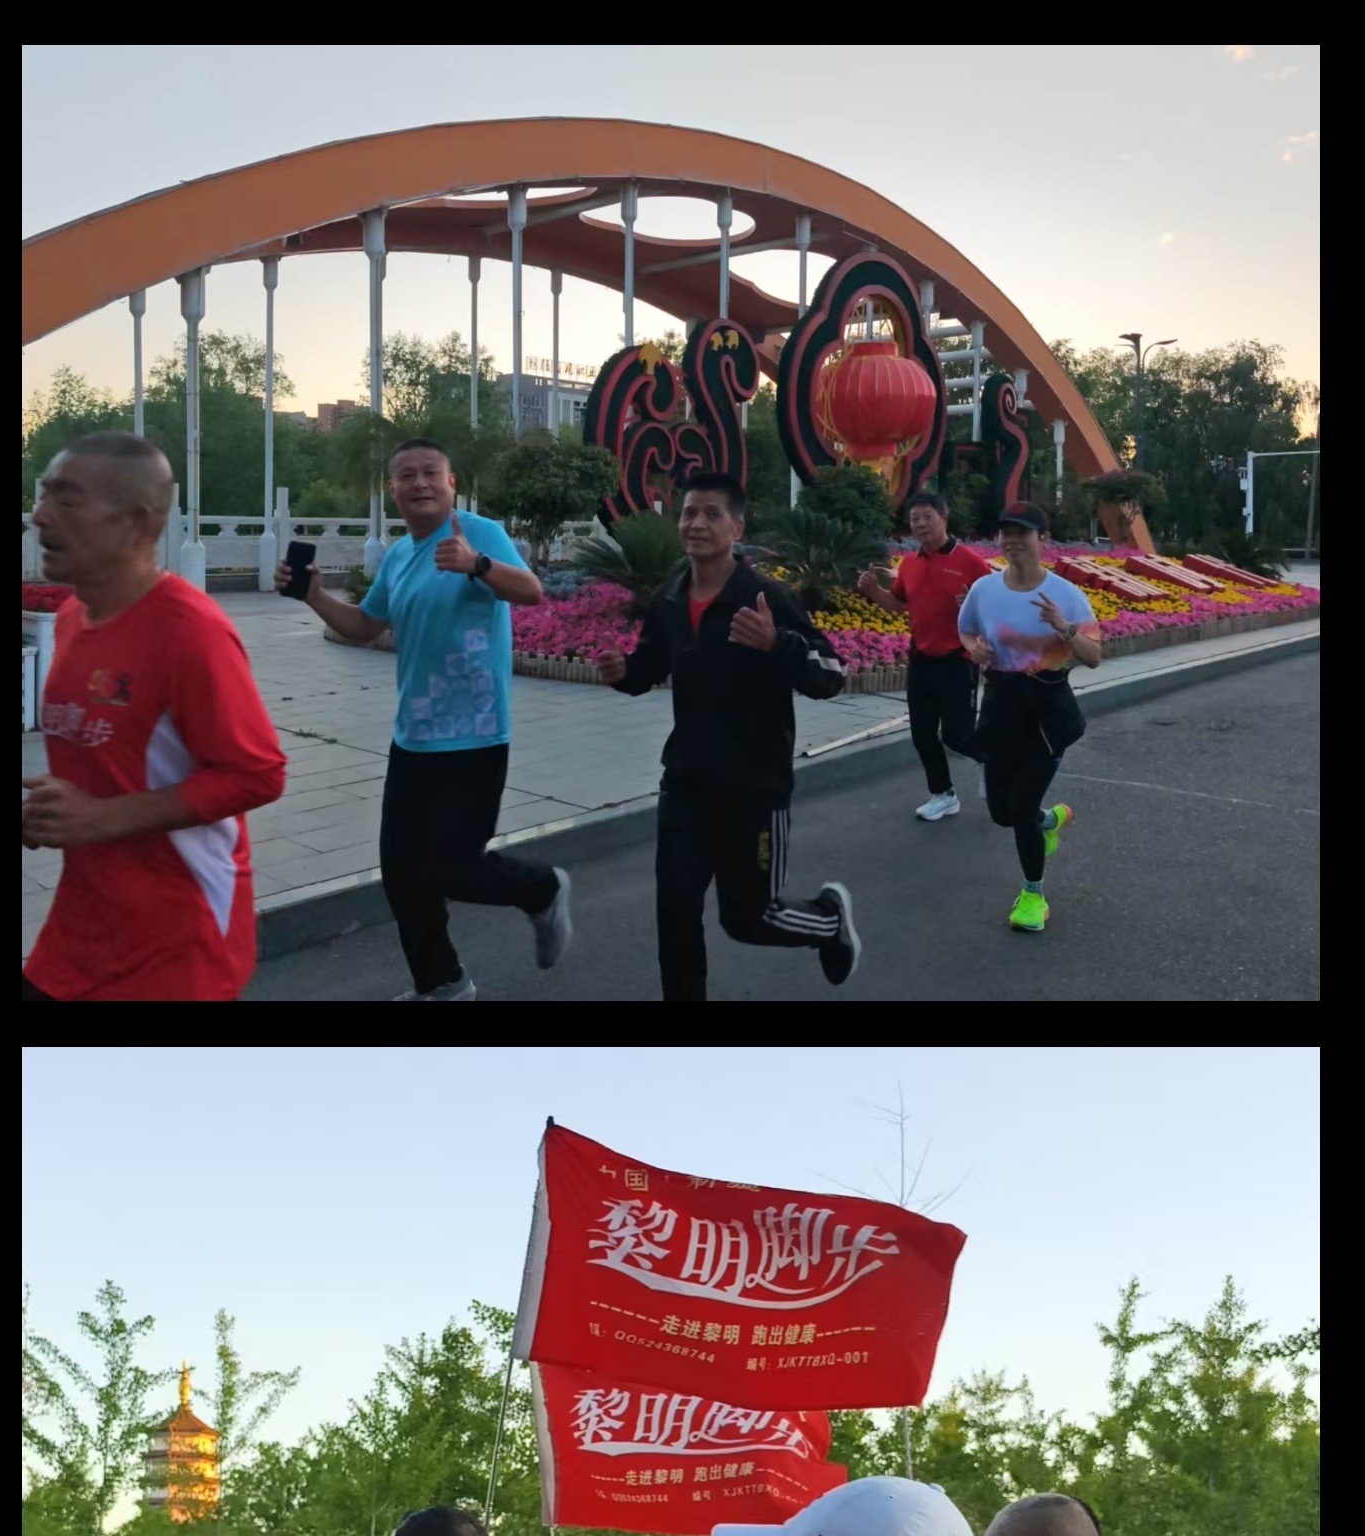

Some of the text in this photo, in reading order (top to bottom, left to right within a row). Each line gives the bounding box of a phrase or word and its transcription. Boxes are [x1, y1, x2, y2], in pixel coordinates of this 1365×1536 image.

[585, 1198, 901, 1310] 黎明脚步
[659, 1314, 817, 1346] 走进黎明 跑出健康
